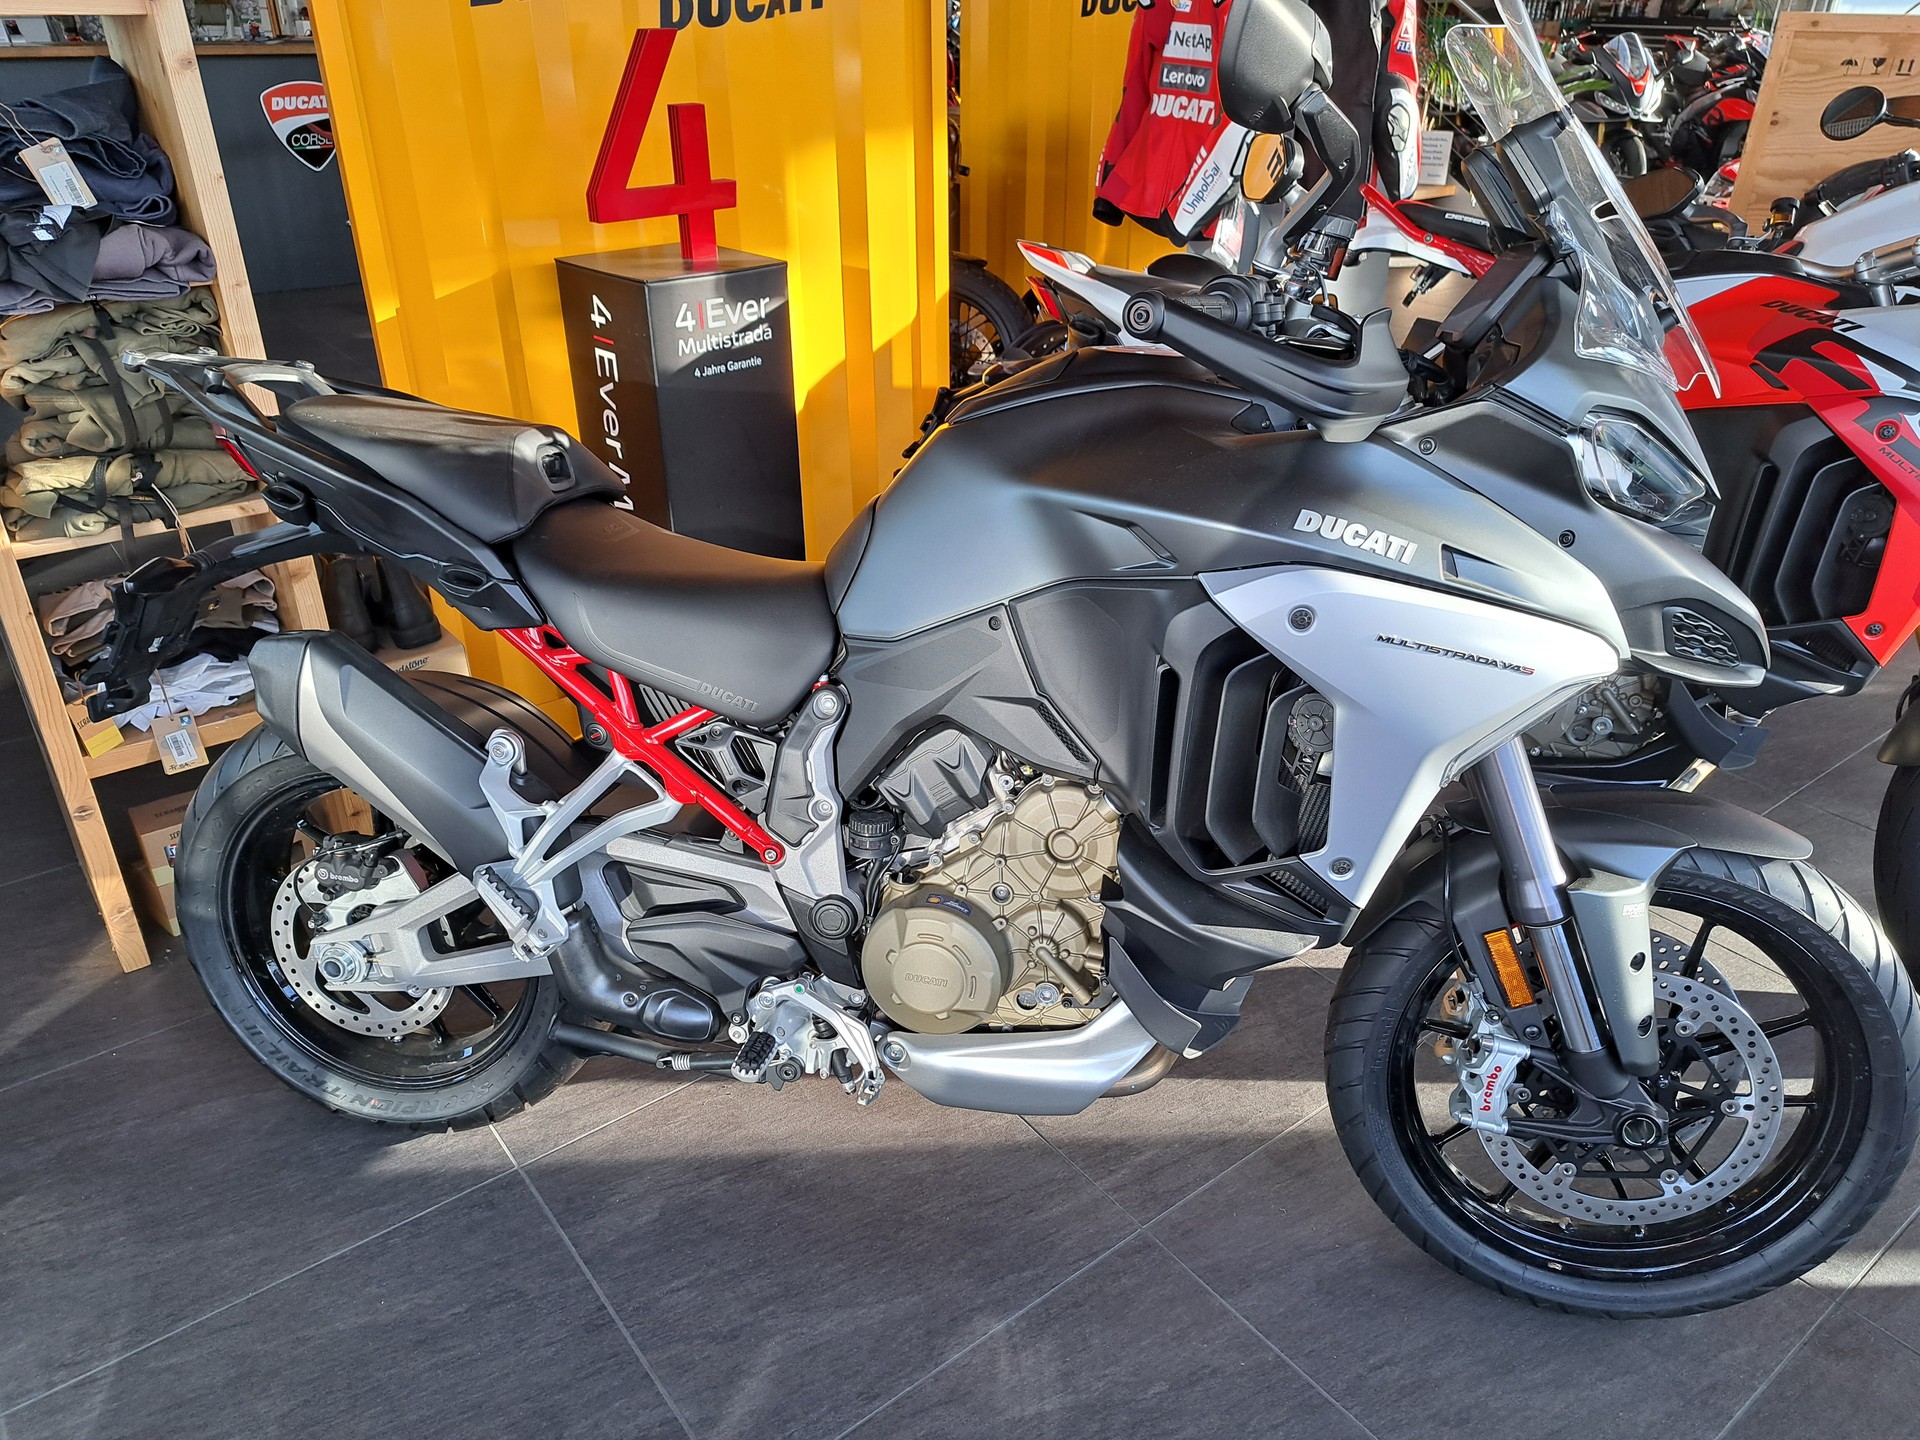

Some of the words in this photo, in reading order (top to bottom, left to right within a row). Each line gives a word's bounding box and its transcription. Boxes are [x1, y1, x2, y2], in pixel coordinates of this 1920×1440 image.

[659, 0, 824, 31] DUCA
[1162, 68, 1206, 88] Lenovo
[586, 28, 737, 260] 4
[1760, 300, 1867, 333] DUCATI
[678, 323, 773, 357] Multistrada
[694, 367, 701, 378] 4
[702, 364, 726, 377] Jahre
[727, 356, 763, 372] Garantie
[1293, 508, 1419, 565] DUCATI
[698, 682, 760, 714] DUCATI
[330, 871, 360, 883] brembo
[905, 972, 949, 988] DUCATI
[1478, 1065, 1503, 1112] brembo
